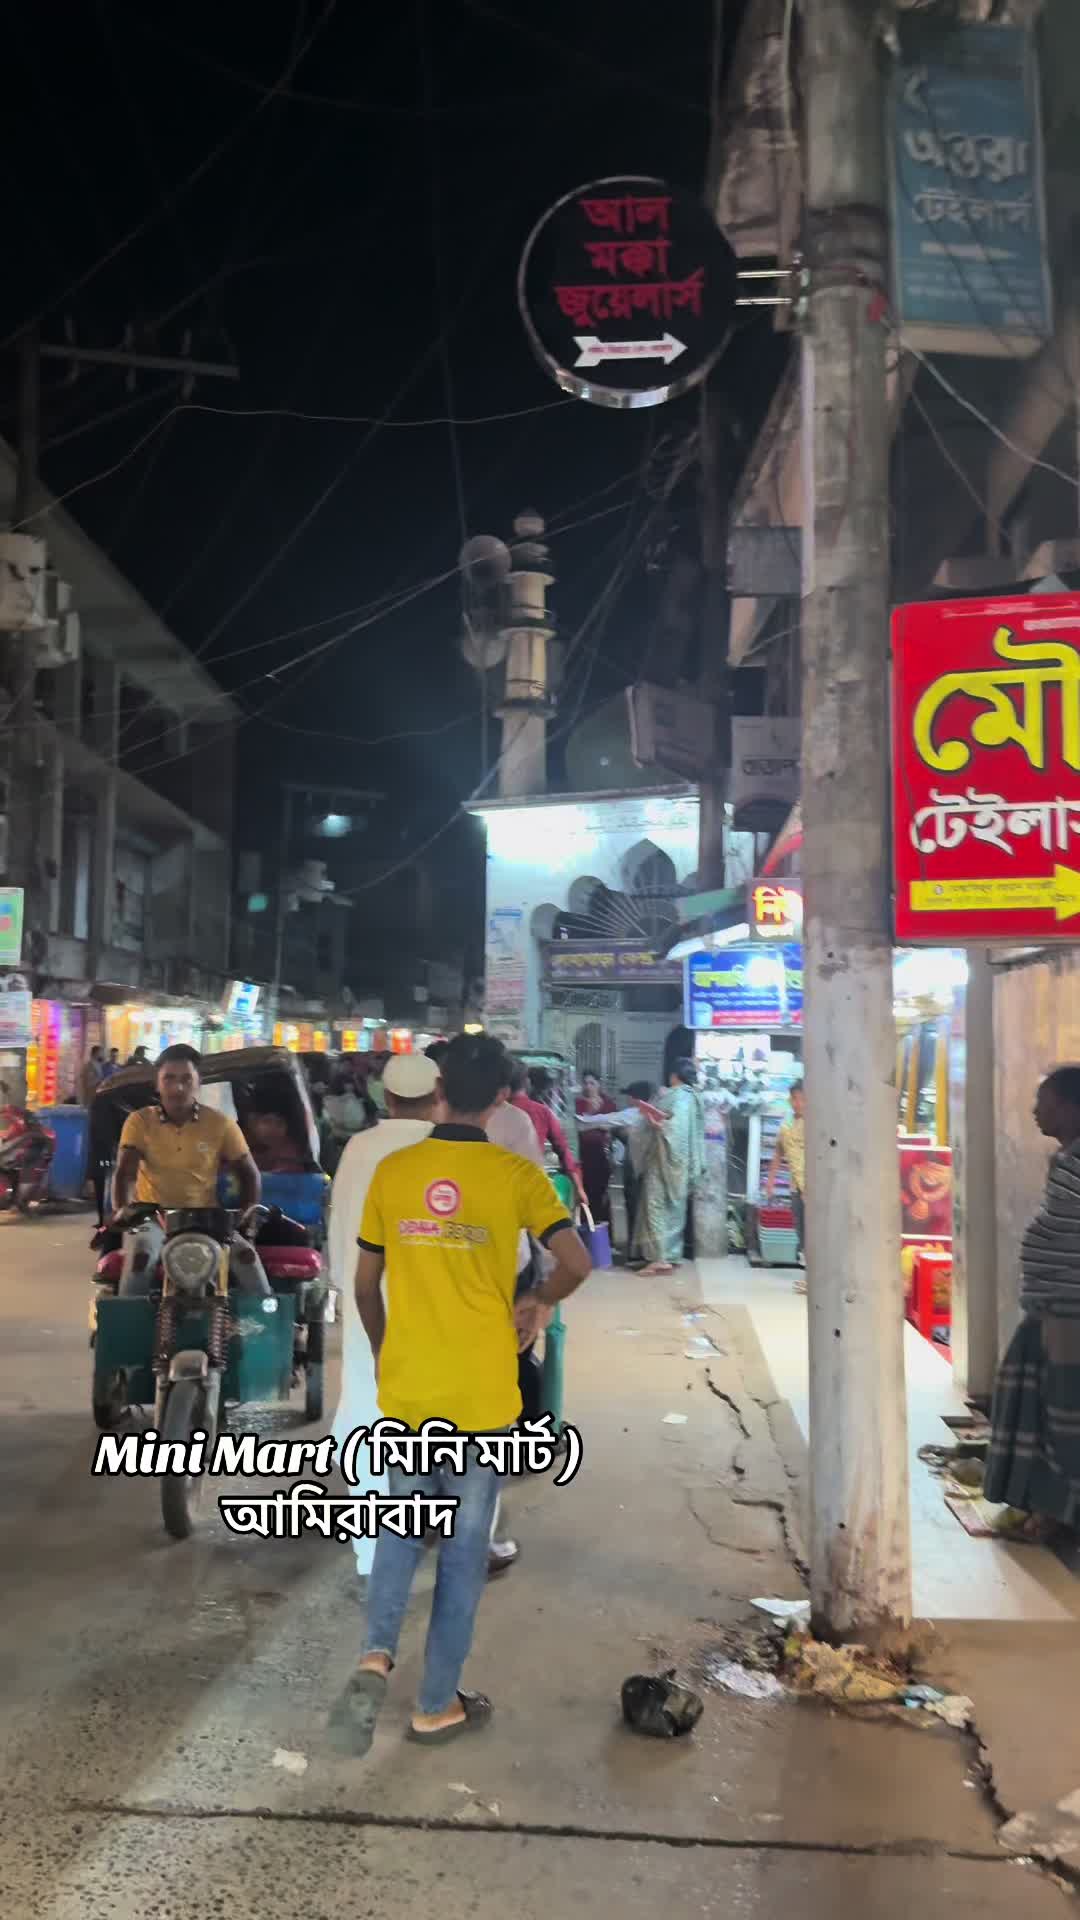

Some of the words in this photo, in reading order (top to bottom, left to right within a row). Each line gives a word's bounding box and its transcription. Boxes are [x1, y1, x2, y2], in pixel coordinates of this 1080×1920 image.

[577, 195, 673, 233] আল
[552, 266, 705, 327] জুয়েলার্স
[909, 786, 1080, 856] টেইলা
